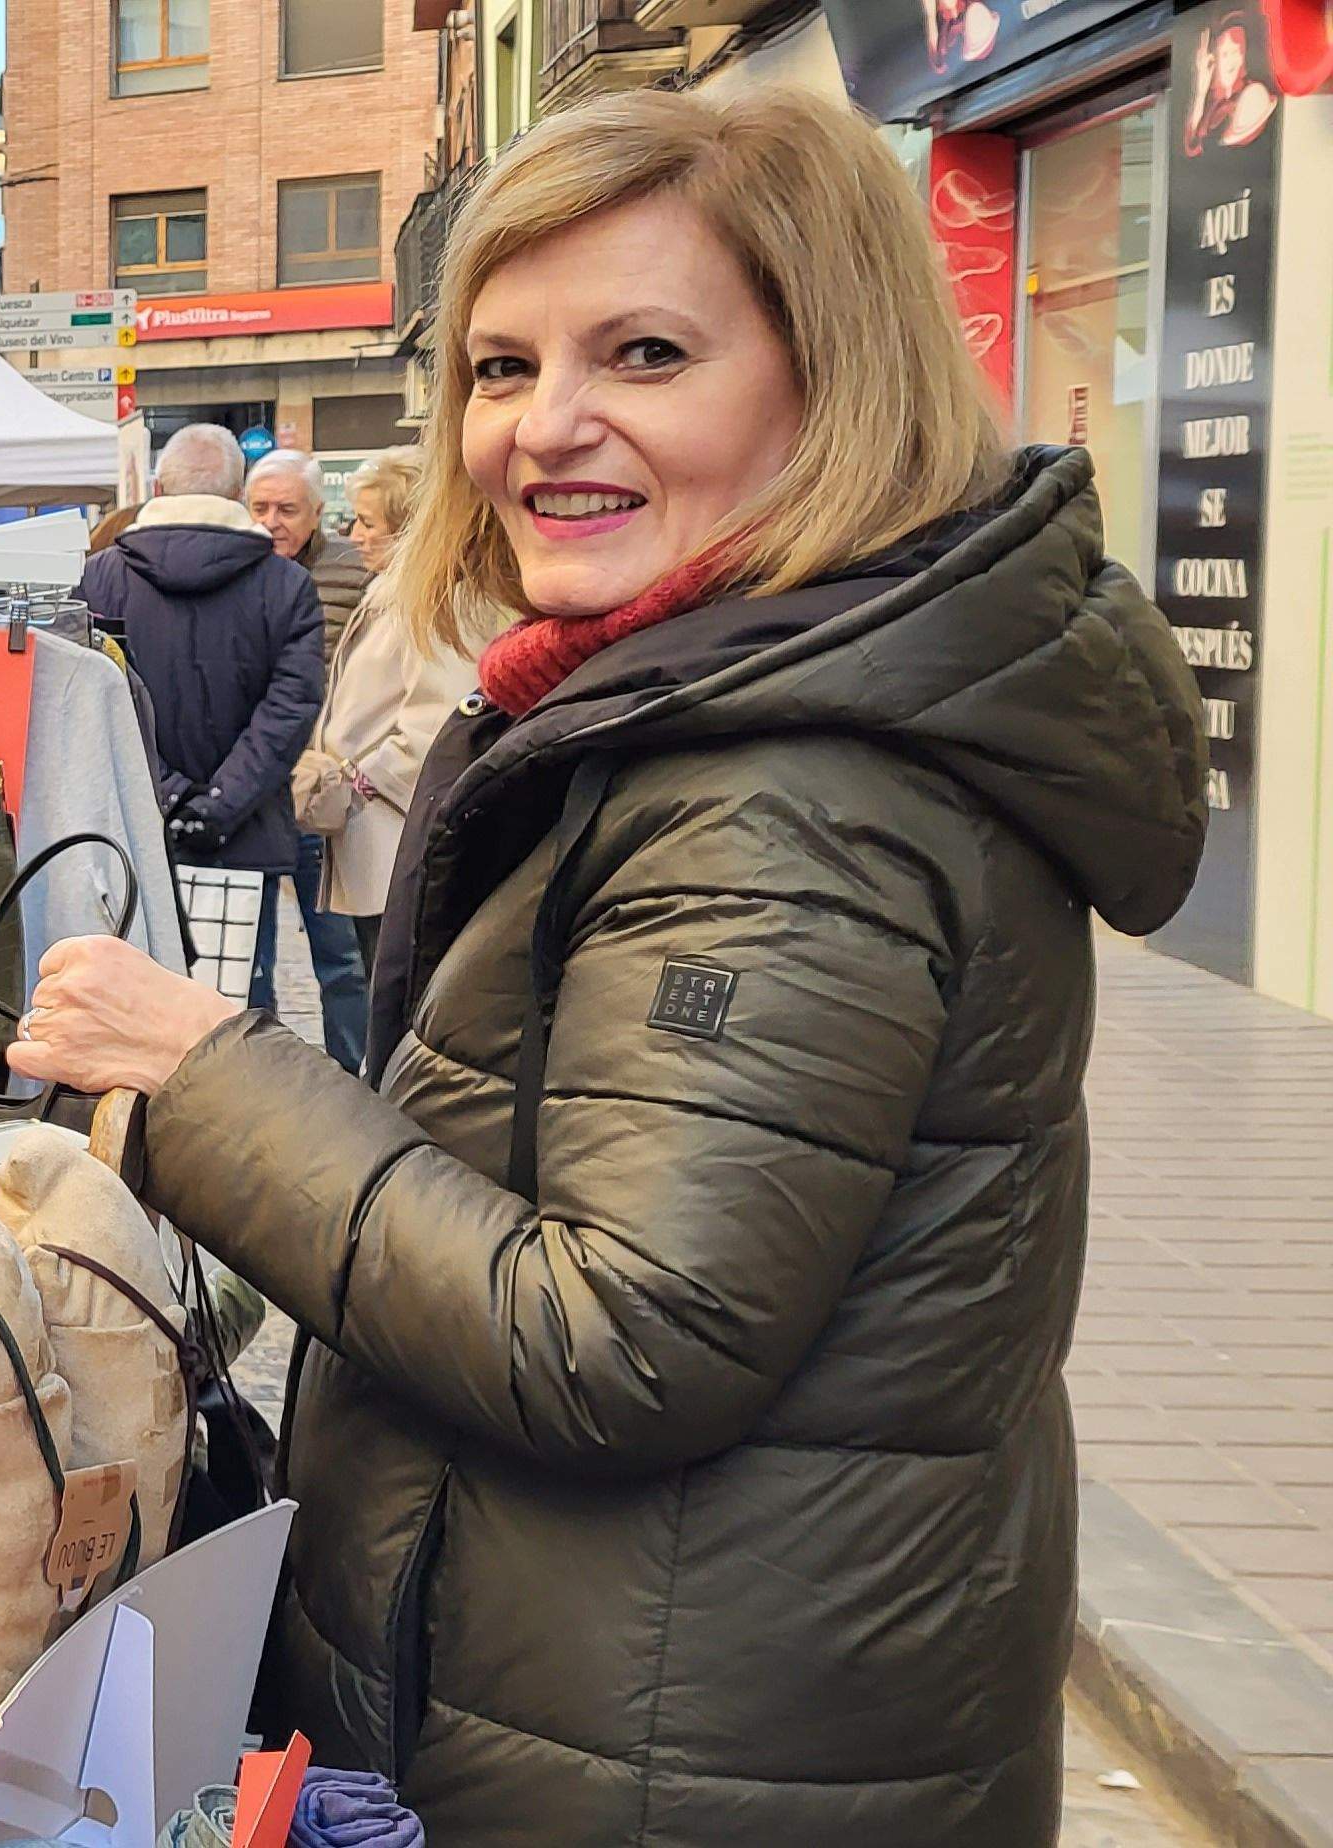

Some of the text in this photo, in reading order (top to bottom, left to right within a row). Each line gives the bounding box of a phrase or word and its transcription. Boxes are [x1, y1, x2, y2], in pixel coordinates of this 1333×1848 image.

[1199, 188, 1252, 256] AQUÍ
[1206, 274, 1236, 318] ES
[31, 334, 47, 346] del
[50, 333, 74, 345] Vino
[61, 369, 94, 382] Centro
[1185, 342, 1255, 391] DONDE
[1183, 415, 1251, 460] MEJOR
[1199, 488, 1228, 528] SE
[1175, 559, 1249, 599] COCINA
